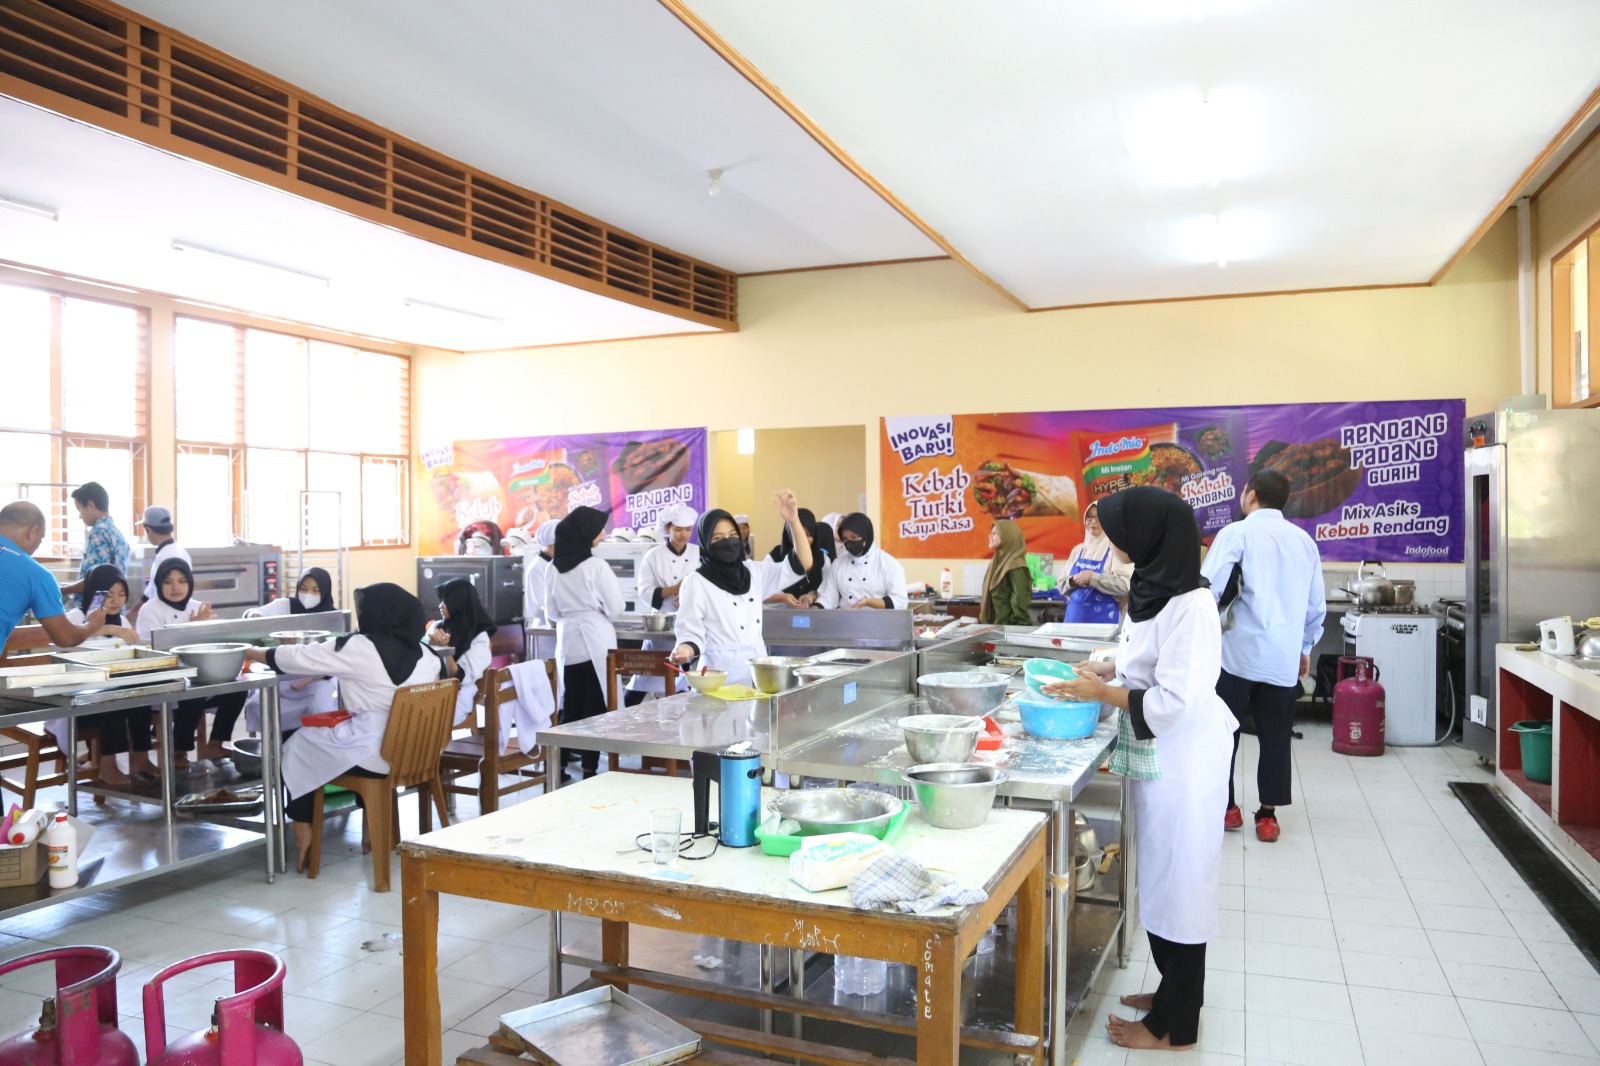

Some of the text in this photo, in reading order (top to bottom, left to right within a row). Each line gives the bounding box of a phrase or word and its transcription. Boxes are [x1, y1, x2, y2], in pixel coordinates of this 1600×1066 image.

[890, 421, 951, 449] INOVASI
[901, 437, 952, 461] BARU!
[1101, 466, 1110, 474] Mi
[1369, 465, 1418, 484] GURIH
[904, 467, 969, 496] Kebab
[1094, 478, 1126, 494] HYPE
[909, 493, 963, 518] Turki
[1187, 487, 1234, 507] ENDANG
[1343, 502, 1419, 521] Mix Asiks
[901, 518, 971, 539] Kaya Rasa
[1317, 517, 1447, 539] Kebab Rendang
[1404, 545, 1450, 557] Indofood
